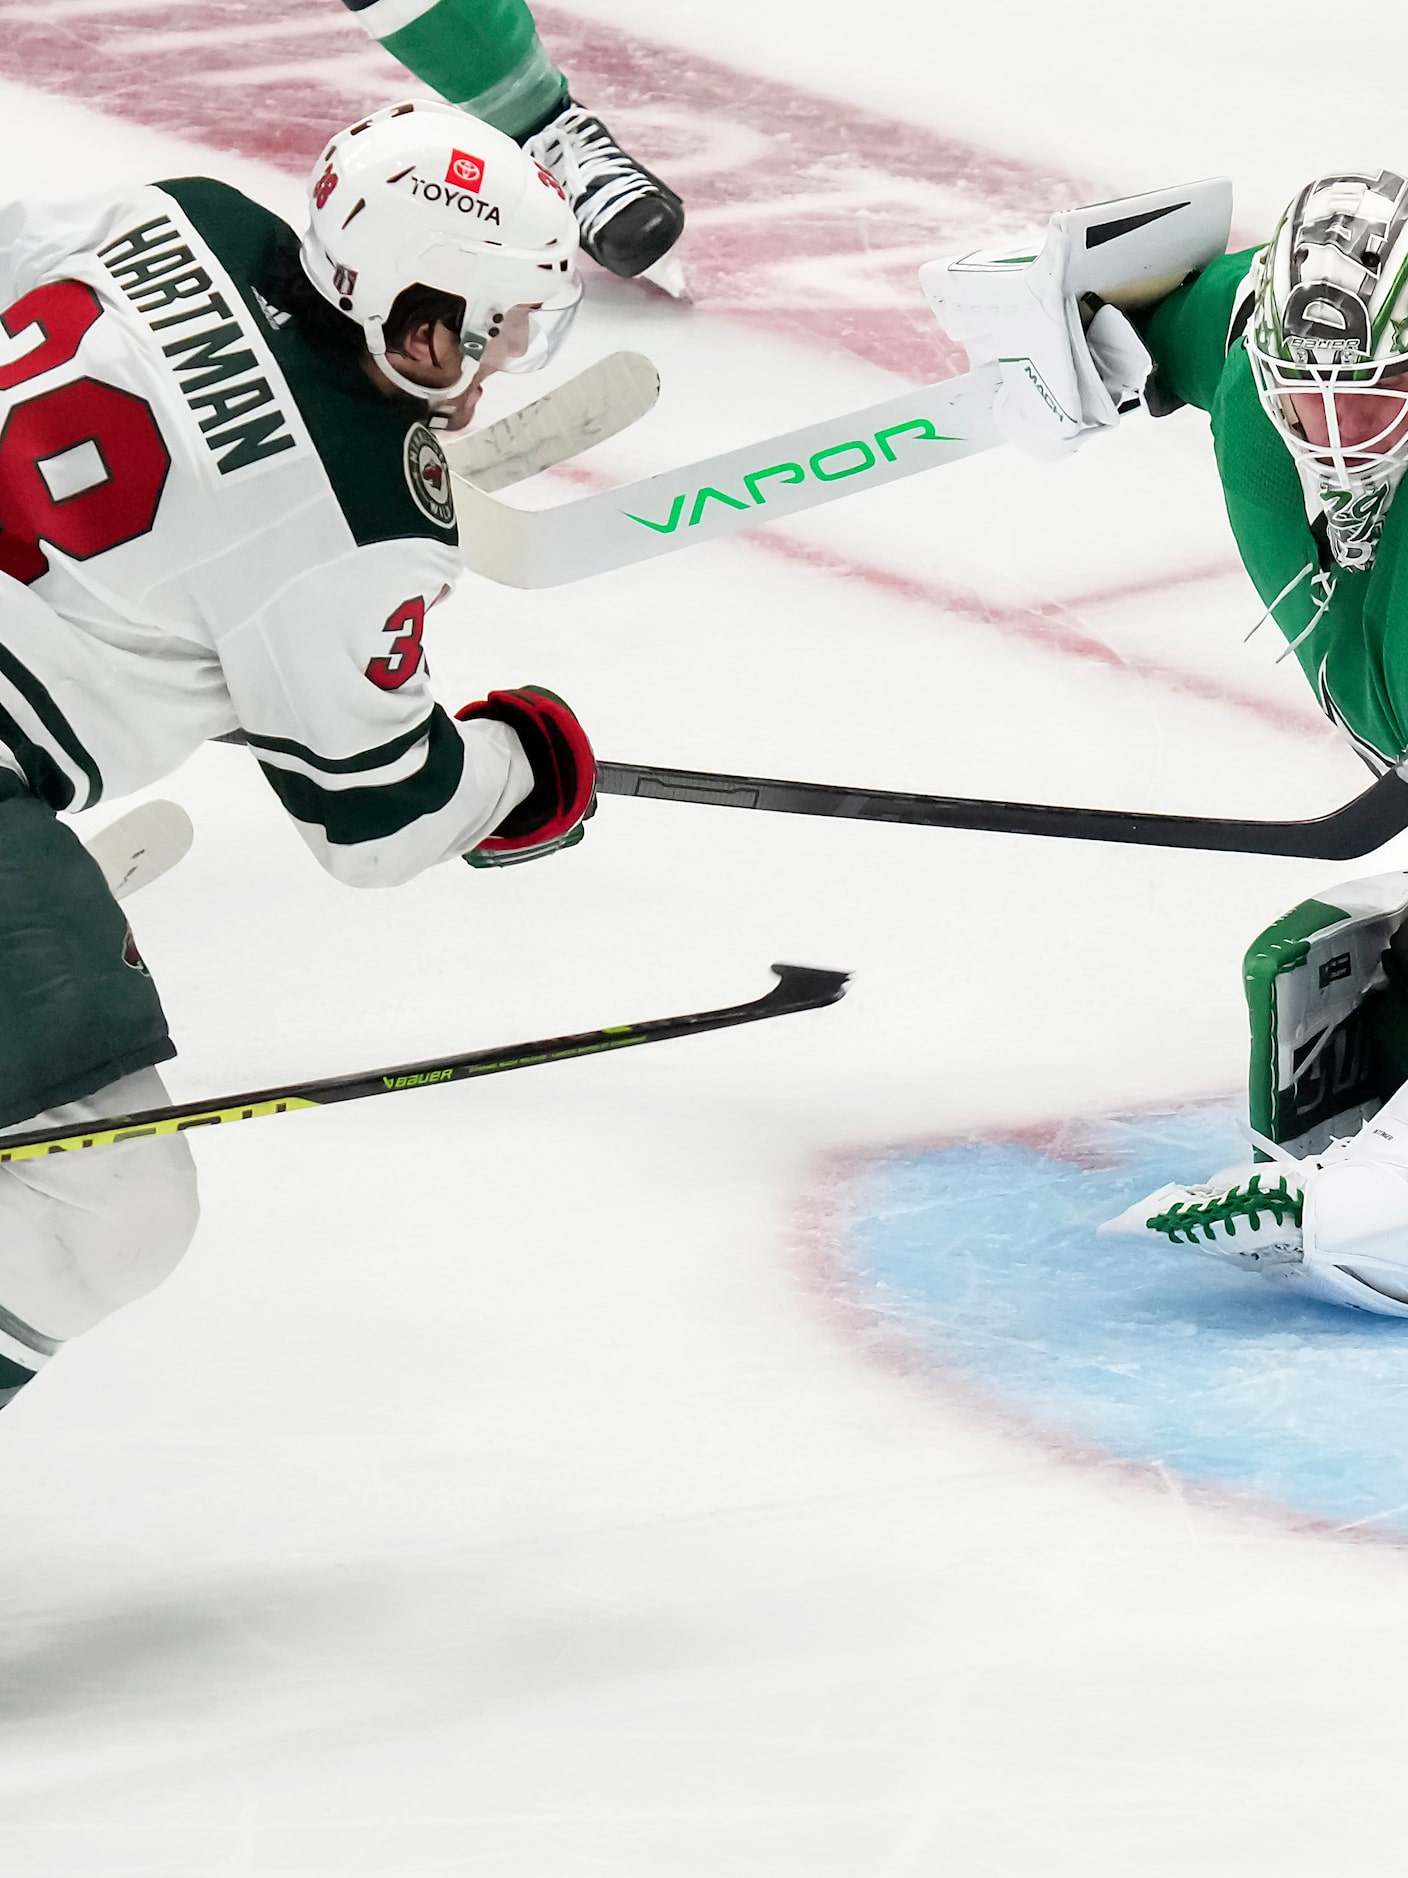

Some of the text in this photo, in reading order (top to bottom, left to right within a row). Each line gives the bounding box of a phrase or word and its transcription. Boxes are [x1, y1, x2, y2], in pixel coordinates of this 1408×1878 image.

[411, 176, 500, 226] TOYOTA
[97, 214, 297, 476] HARTMAN
[1024, 366, 1063, 422] MACH
[615, 418, 969, 535] VAPOR
